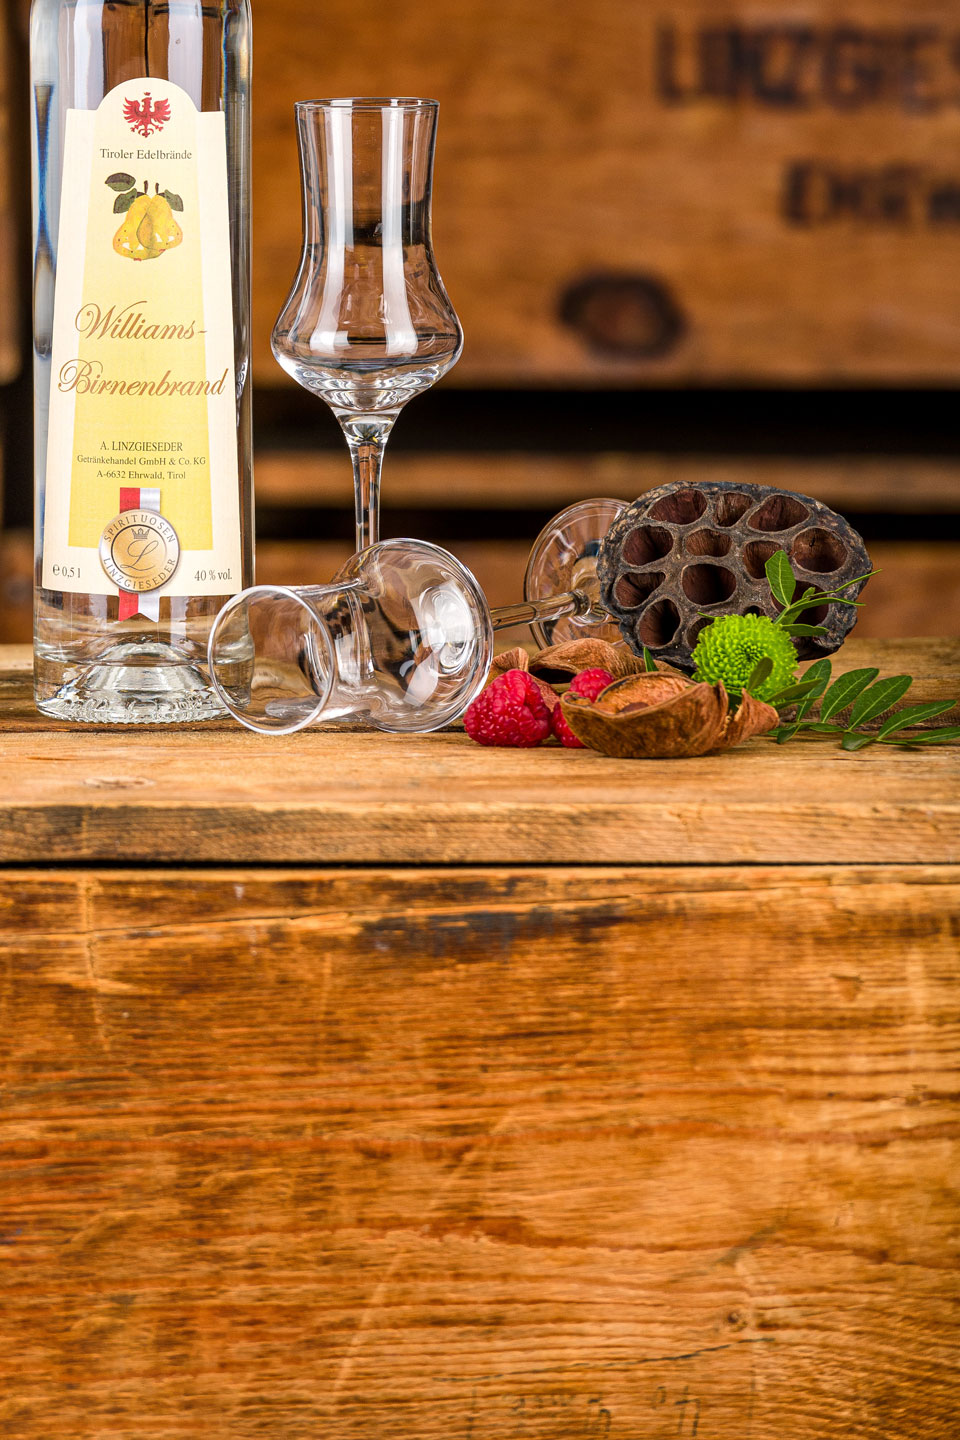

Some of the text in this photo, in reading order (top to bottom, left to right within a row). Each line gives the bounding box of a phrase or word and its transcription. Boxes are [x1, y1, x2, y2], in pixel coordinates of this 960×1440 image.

[99, 148, 192, 160] Tiroler Edelbrände
[75, 300, 208, 341] Williams-
[58, 358, 229, 397] Birnenbrand
[100, 441, 183, 452] A. LINZGIESEDER
[76, 454, 206, 466] Getränkehandel GmbH & Co. KG
[96, 470, 186, 480] A-6632 Ehrwald, Tirol
[103, 514, 175, 543] SPIRITUOSEN
[61, 566, 75, 578] 0,5
[103, 557, 176, 590] LINZGIESEDER
[194, 568, 232, 581] 40 % vol.
